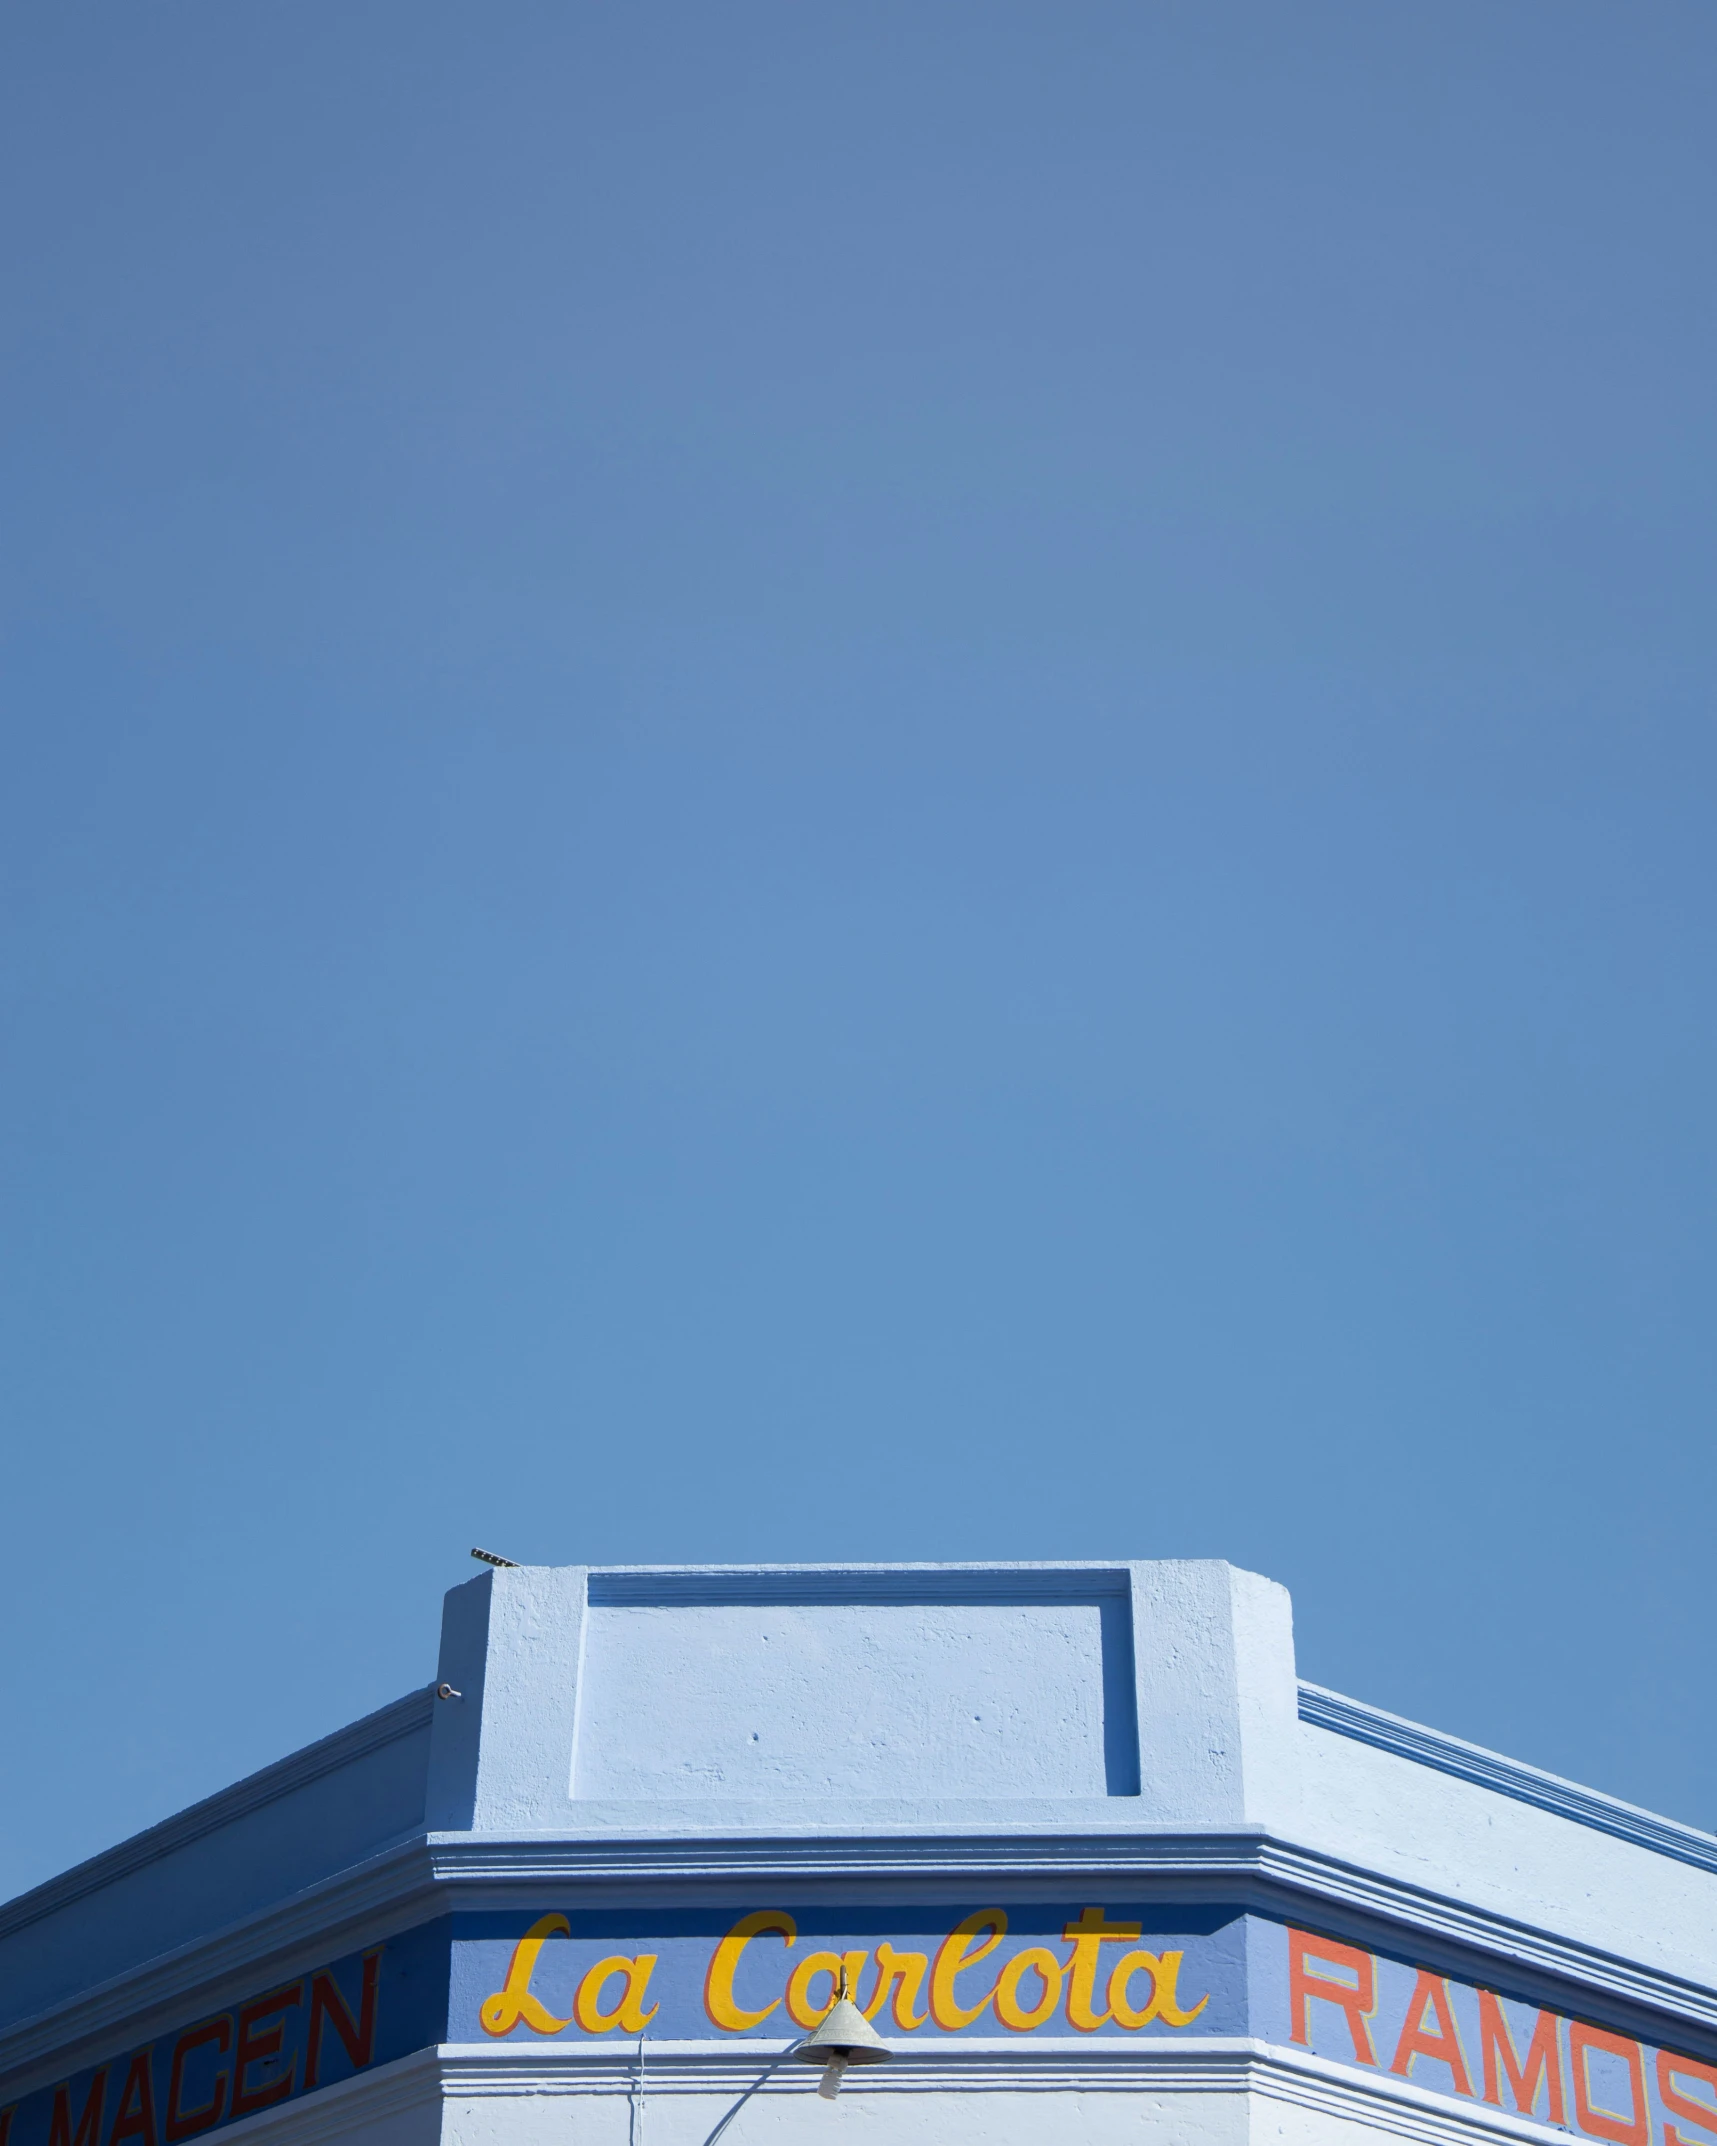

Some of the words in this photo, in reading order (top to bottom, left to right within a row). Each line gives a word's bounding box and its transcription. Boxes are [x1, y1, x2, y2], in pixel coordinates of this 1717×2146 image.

[0, 1944, 385, 2146] MACEN
[480, 1913, 660, 2037] La
[704, 1907, 1209, 2033] Carlota
